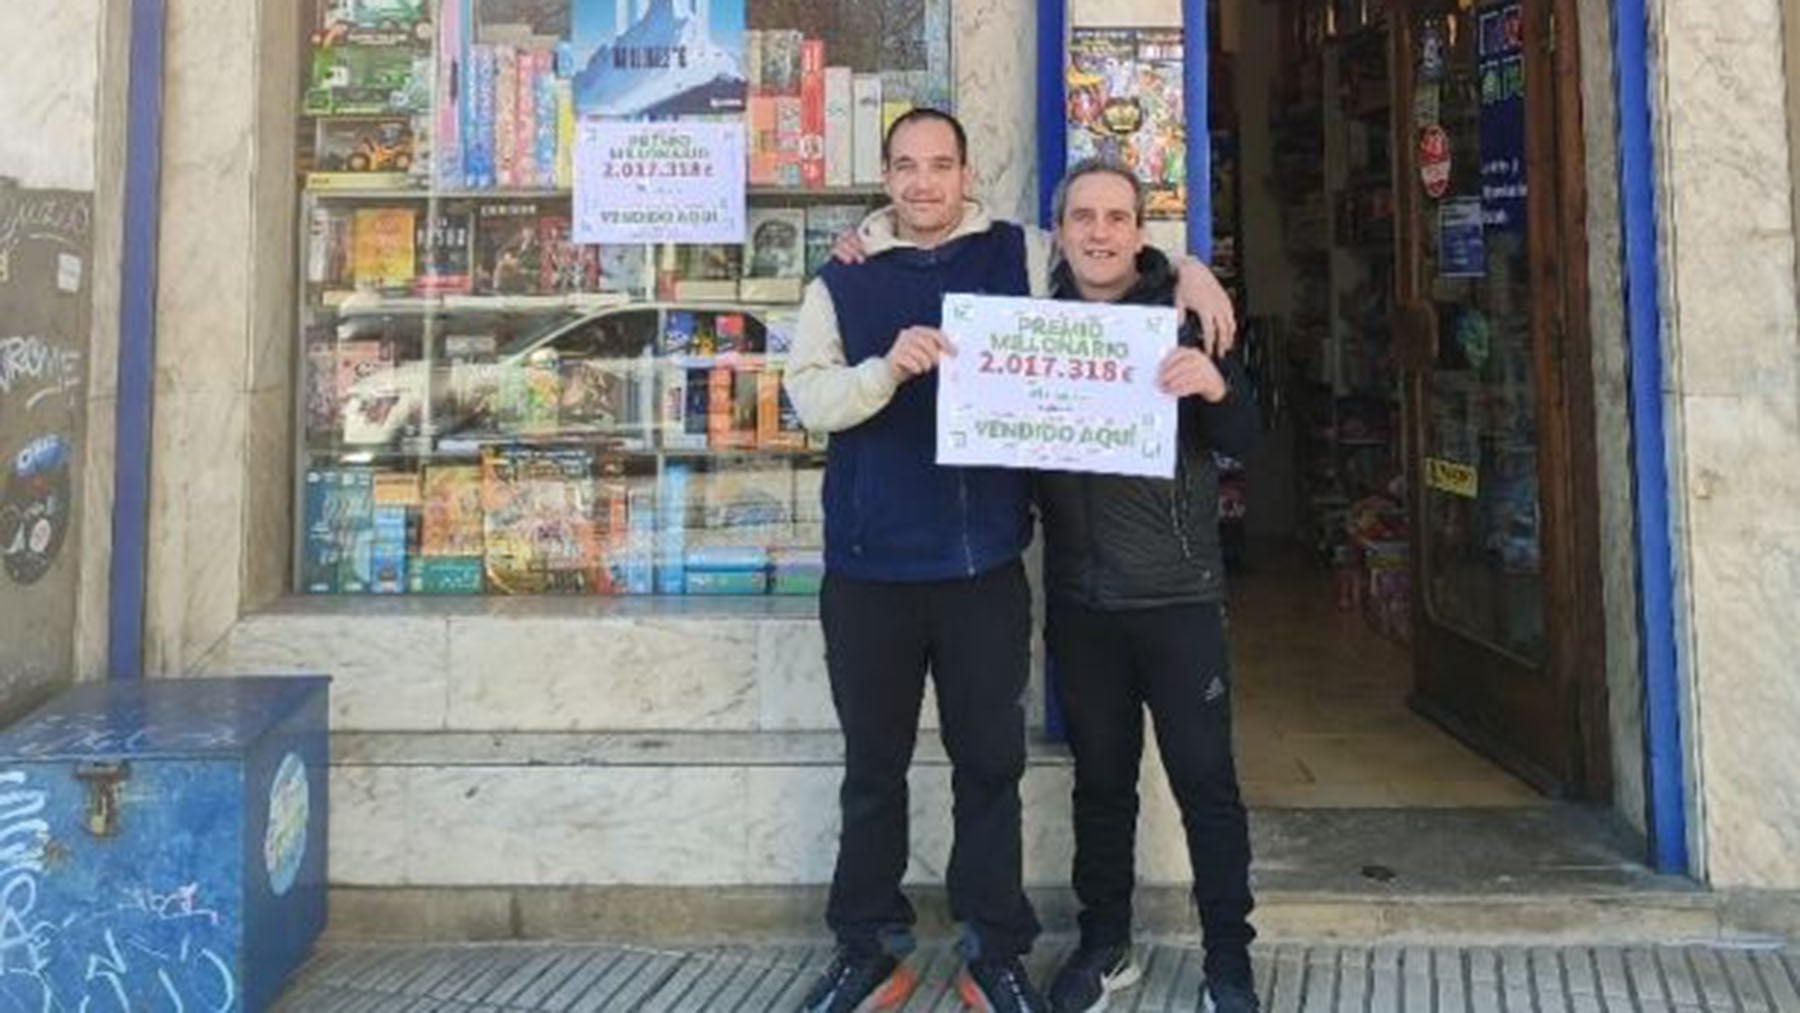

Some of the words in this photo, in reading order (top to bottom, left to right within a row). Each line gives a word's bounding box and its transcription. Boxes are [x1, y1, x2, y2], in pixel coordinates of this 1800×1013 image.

[1018, 316, 1104, 338] PREMIO
[990, 332, 1129, 359] MILLONARIO
[974, 419, 1076, 443] VENDIDO
